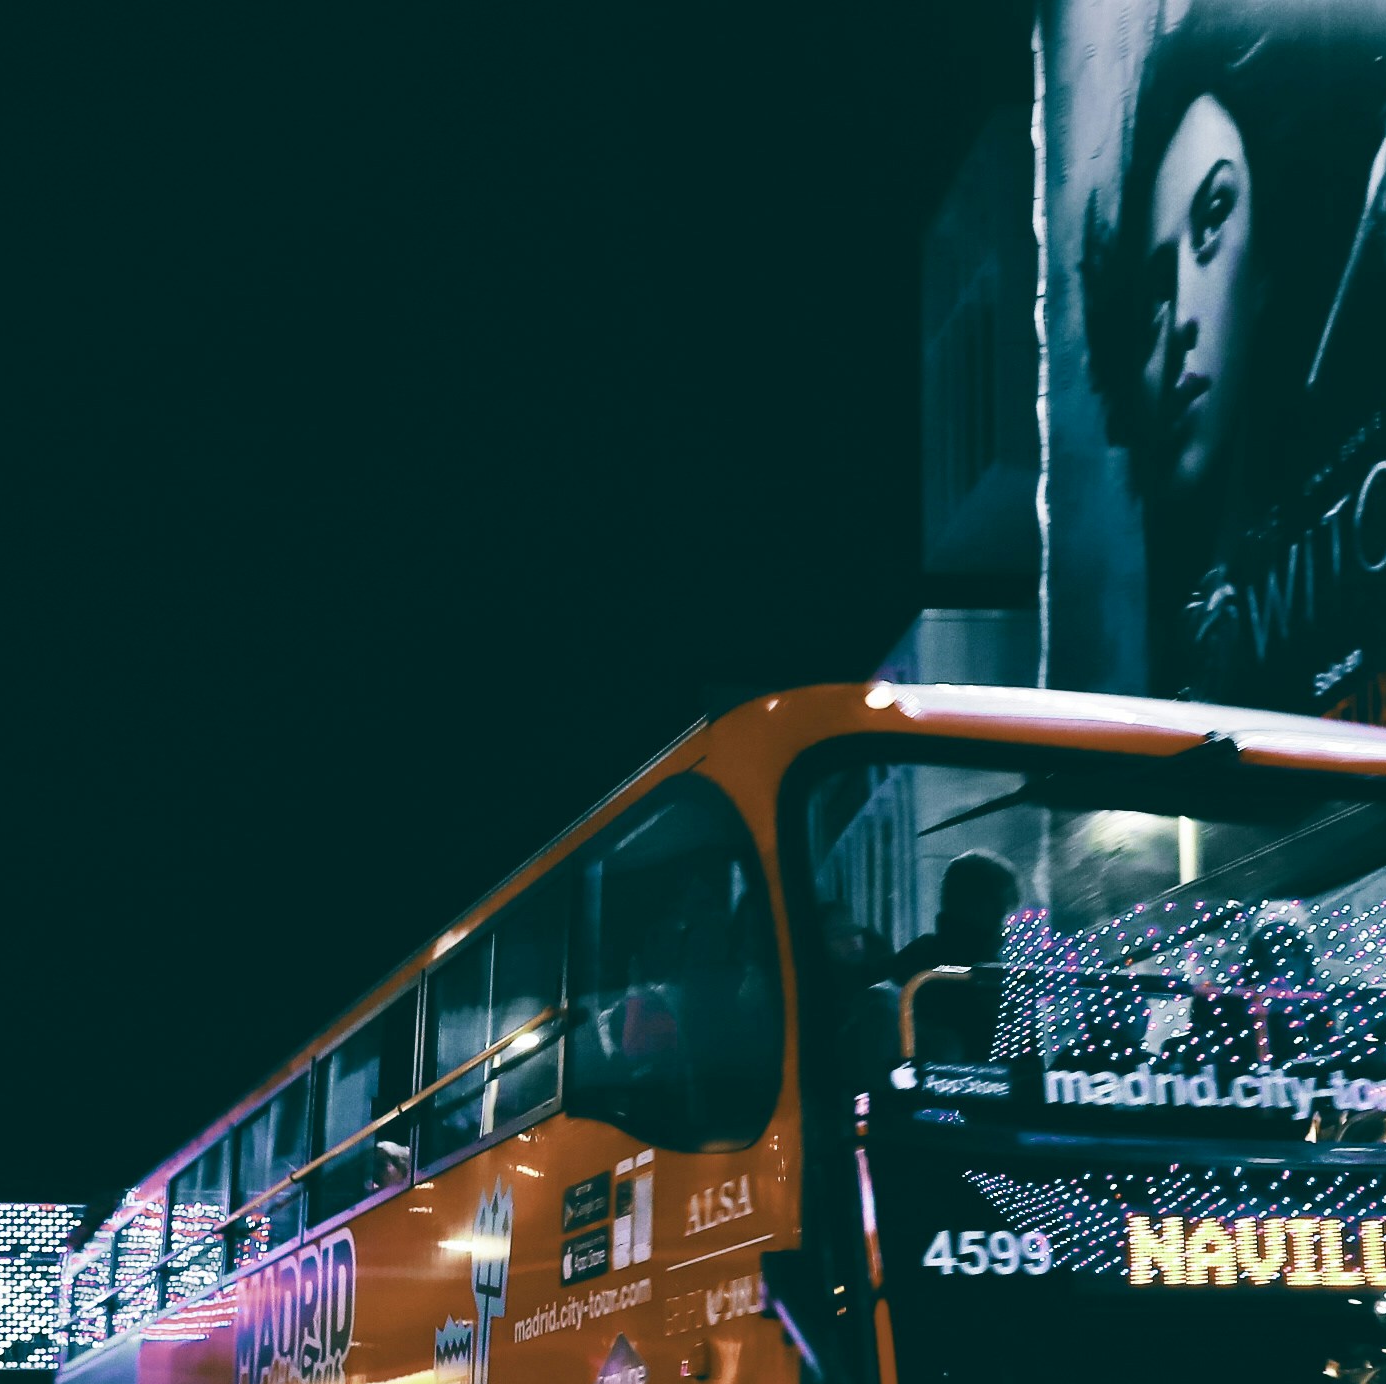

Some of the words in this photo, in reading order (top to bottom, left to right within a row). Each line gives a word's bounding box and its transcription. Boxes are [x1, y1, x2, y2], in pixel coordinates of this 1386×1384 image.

[684, 1173, 754, 1237] ALSA
[922, 1230, 1053, 1276] 4599
[514, 1278, 652, 1343] madrid.city-tour.com
